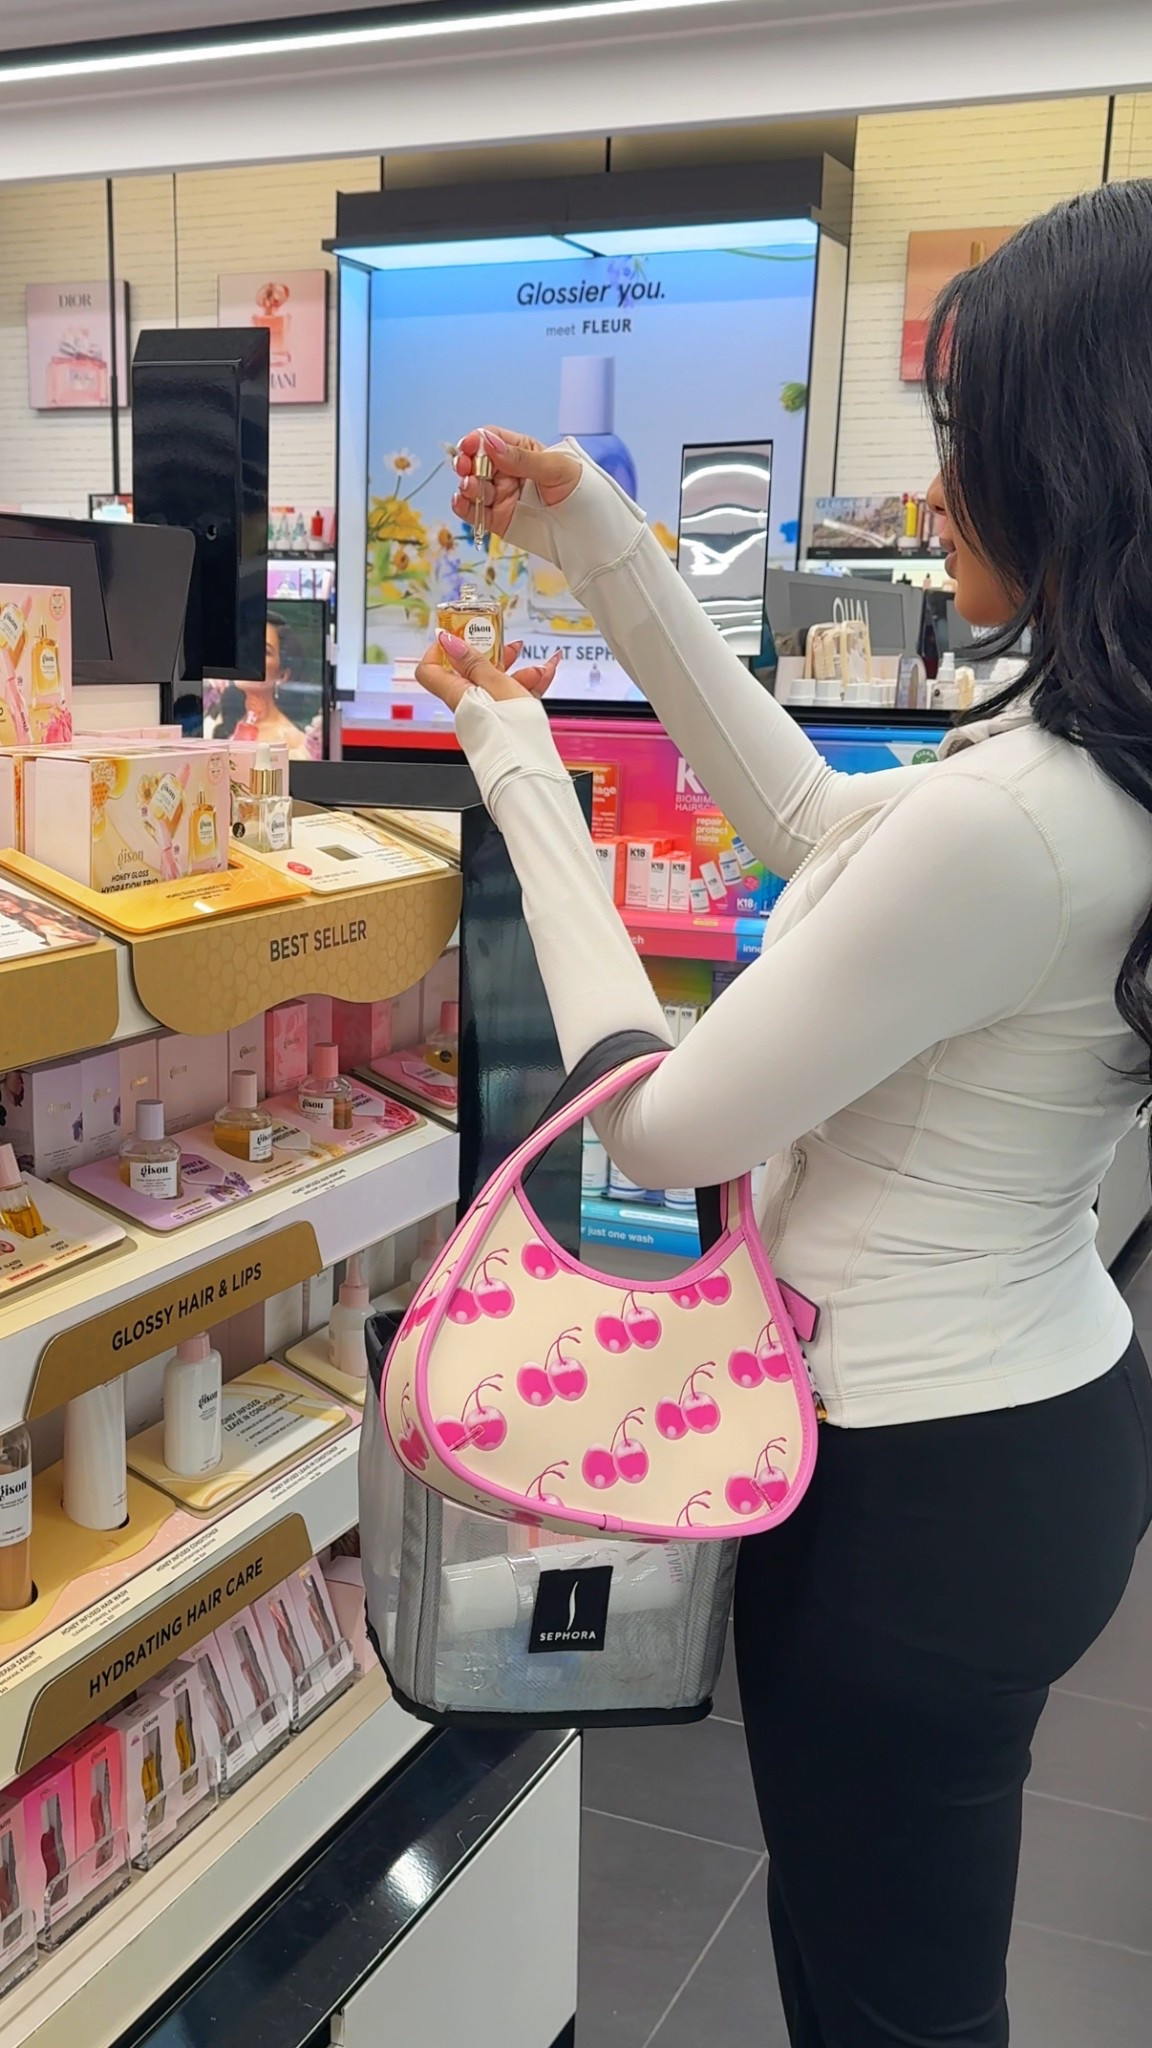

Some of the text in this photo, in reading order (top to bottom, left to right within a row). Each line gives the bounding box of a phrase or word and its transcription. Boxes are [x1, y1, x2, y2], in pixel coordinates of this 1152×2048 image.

[59, 293, 92, 308] DIOR
[517, 280, 665, 307] Glossier you.
[546, 318, 632, 336] meet FLEUR
[522, 645, 549, 660] NLY
[630, 848, 646, 858] K18
[651, 862, 664, 871] K18
[672, 862, 686, 872] K18
[112, 873, 132, 882] HONEY
[736, 897, 754, 910] K18
[270, 920, 367, 962] BEST SELLER
[140, 1164, 169, 1178] gisou
[588, 1226, 607, 1237] just
[608, 1229, 627, 1240] one
[628, 1231, 654, 1244] wash
[112, 1262, 262, 1352] GLOSSY HAIR & LIPS
[224, 1417, 244, 1432] LEAVE
[249, 1393, 286, 1417] CONDITIONER
[236, 1399, 261, 1416] INFUSED
[61, 1621, 80, 1636] HONEY
[79, 1607, 102, 1624] INFUSED
[101, 1598, 113, 1610] HAIR
[113, 1589, 129, 1603] WASH
[89, 1557, 265, 1698] HYDRATING HAIR CARE
[540, 1630, 597, 1643] SEPHORA
[16, 1650, 37, 1665] SERUM
